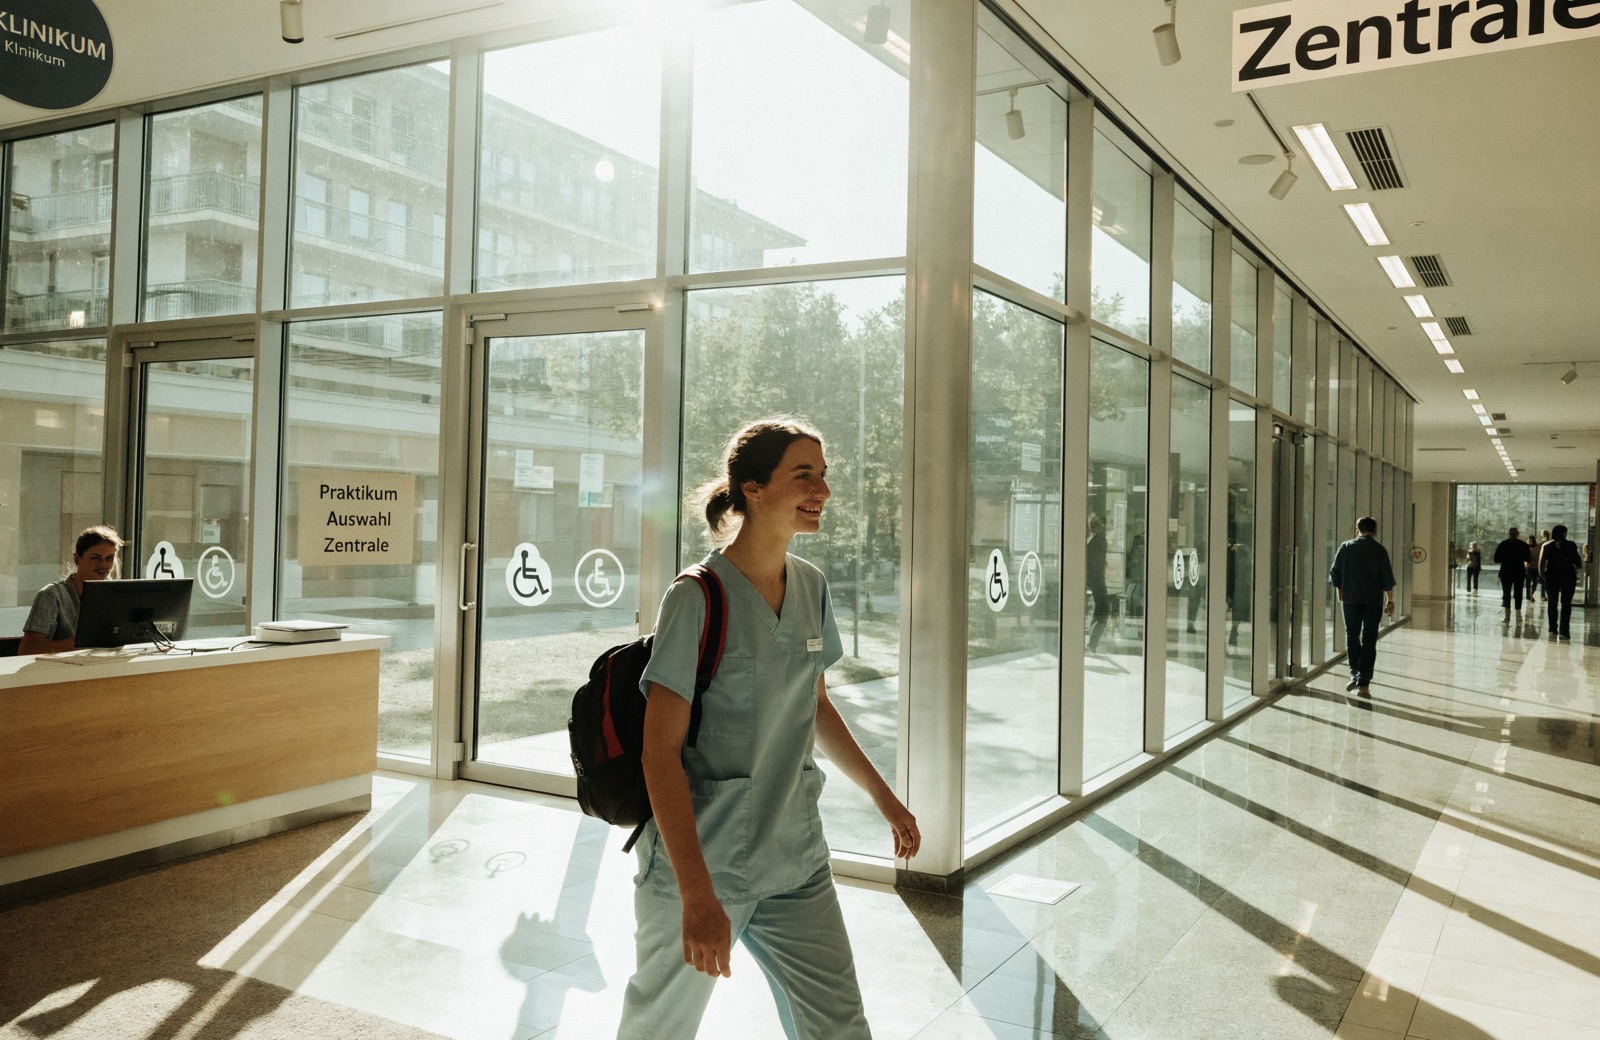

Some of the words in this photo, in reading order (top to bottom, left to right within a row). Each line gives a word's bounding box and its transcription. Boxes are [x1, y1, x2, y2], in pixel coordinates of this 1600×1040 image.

[320, 484, 398, 501] Praktikum
[326, 510, 391, 526] Auswahl
[323, 537, 389, 552] Zentrale
